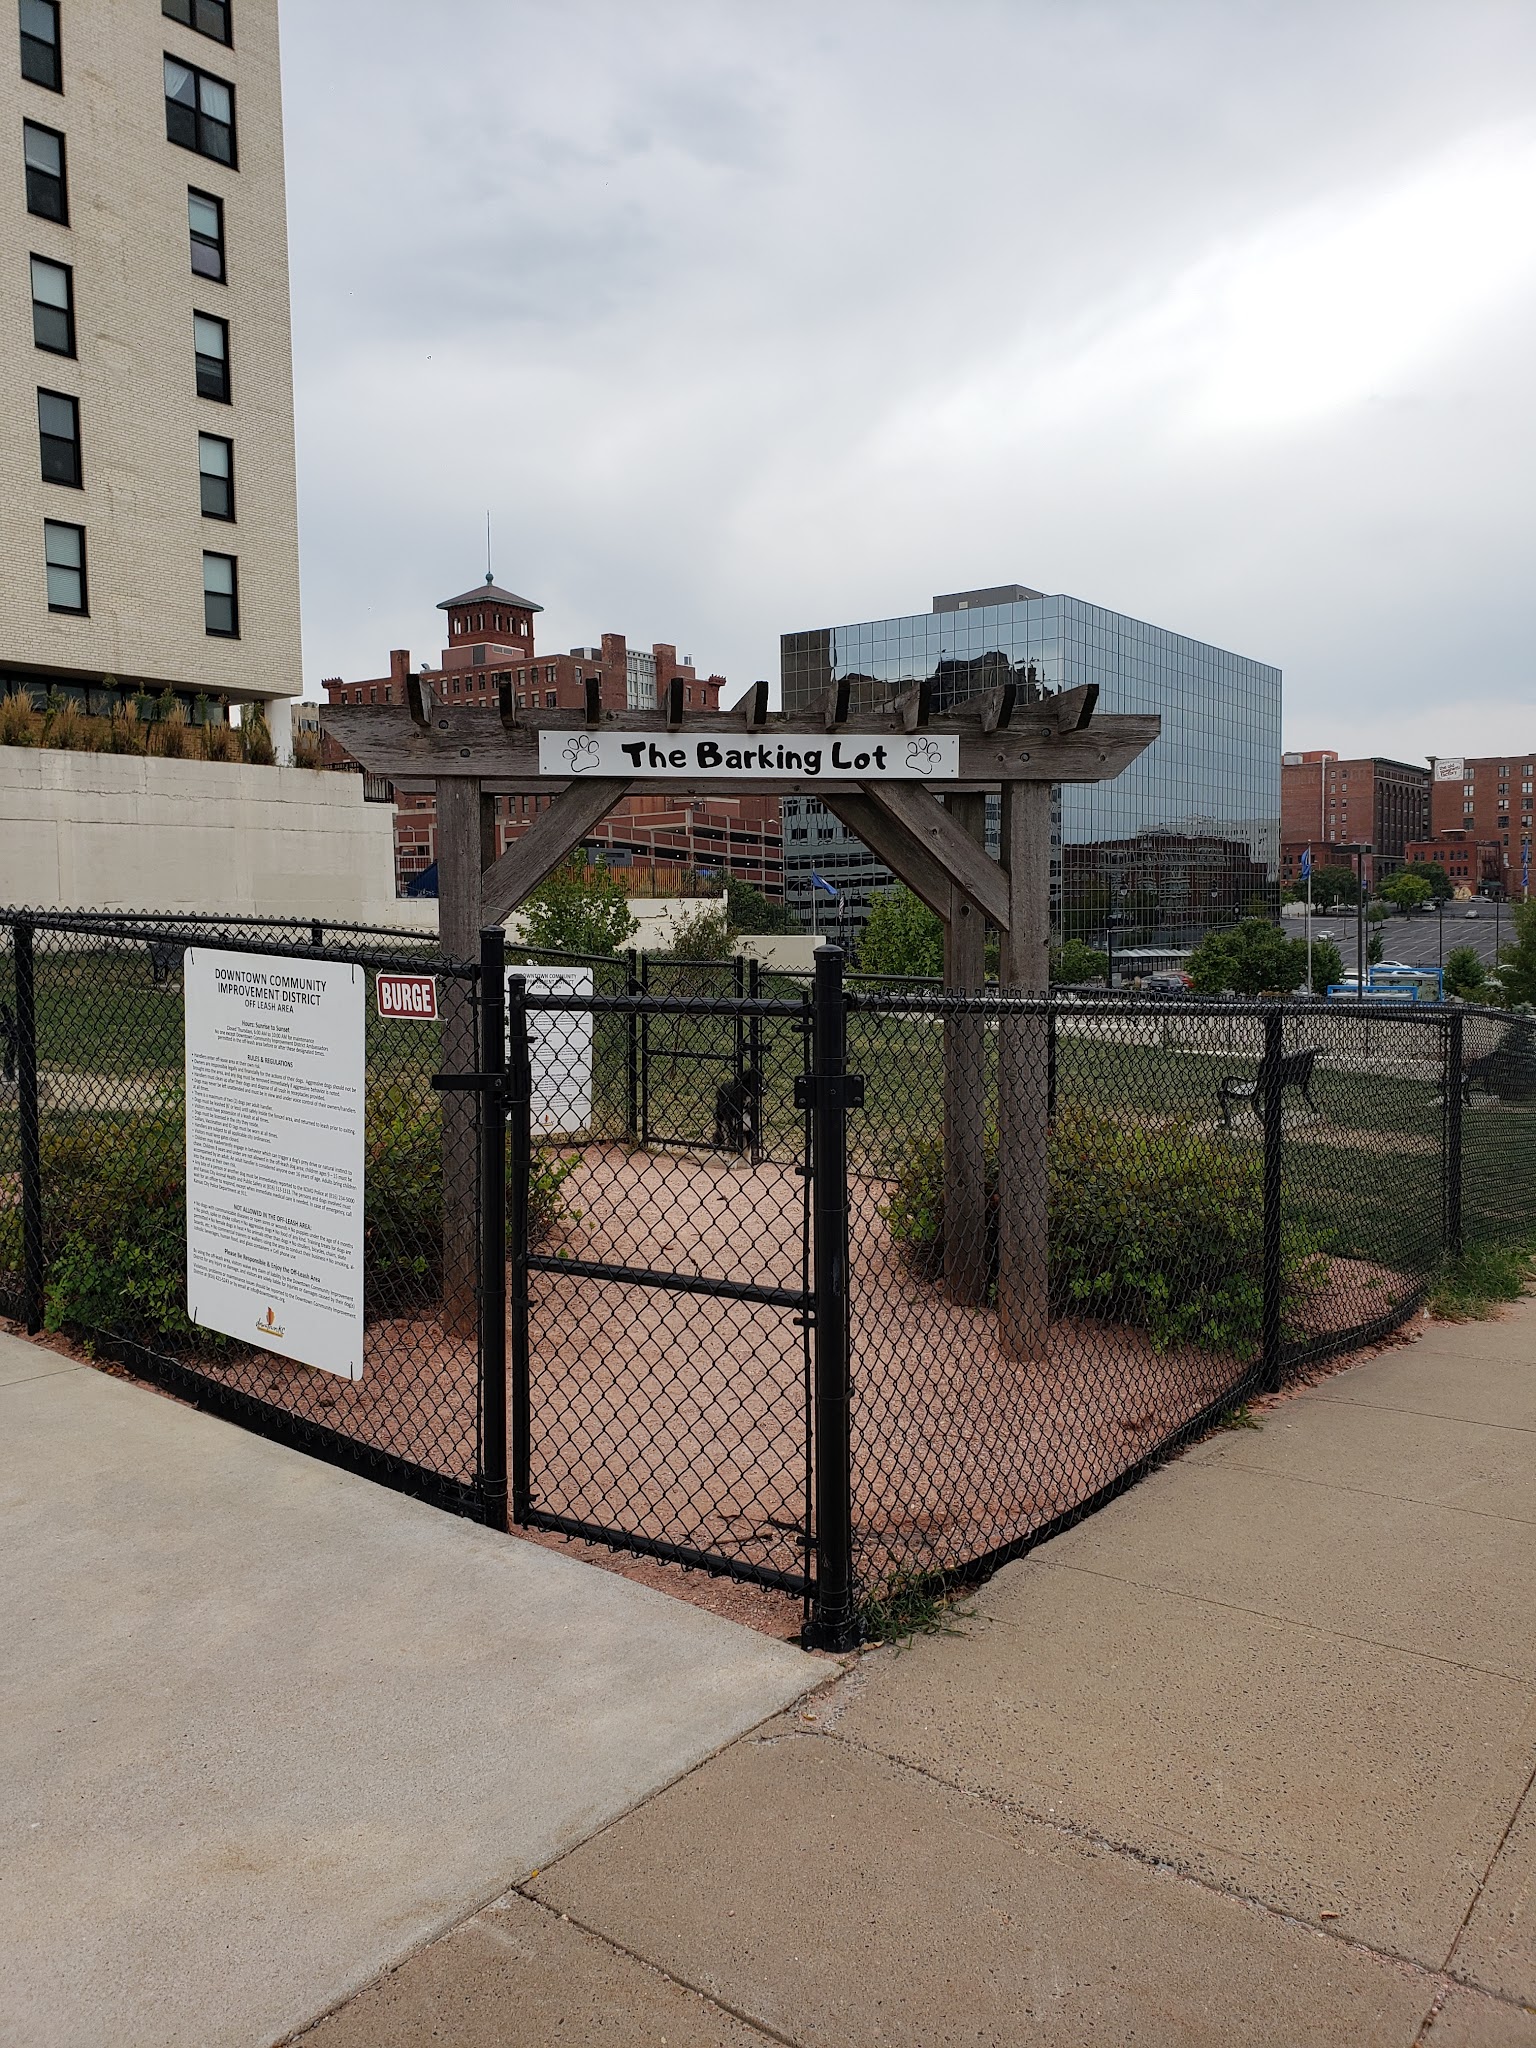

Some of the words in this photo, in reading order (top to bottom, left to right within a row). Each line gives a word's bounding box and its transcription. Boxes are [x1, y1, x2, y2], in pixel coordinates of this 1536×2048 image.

[621, 741, 687, 769] The
[697, 741, 823, 775] Barking
[832, 742, 888, 771] Lot
[215, 968, 267, 985] DOWNTOWN
[270, 975, 327, 992] COMMUNITY
[218, 982, 280, 1001] IMPROVEMENT
[282, 990, 321, 1006] DISTRICT
[382, 982, 432, 1012] BURGE
[245, 999, 256, 1009] OFF
[258, 1001, 276, 1011] LEASH
[277, 1004, 294, 1014] AREA
[242, 1019, 255, 1027] Hours:
[255, 1021, 270, 1030] Sunrise
[276, 1024, 290, 1033] Sunset
[247, 1054, 260, 1062] RULES
[265, 1057, 293, 1067] REGULATIONS
